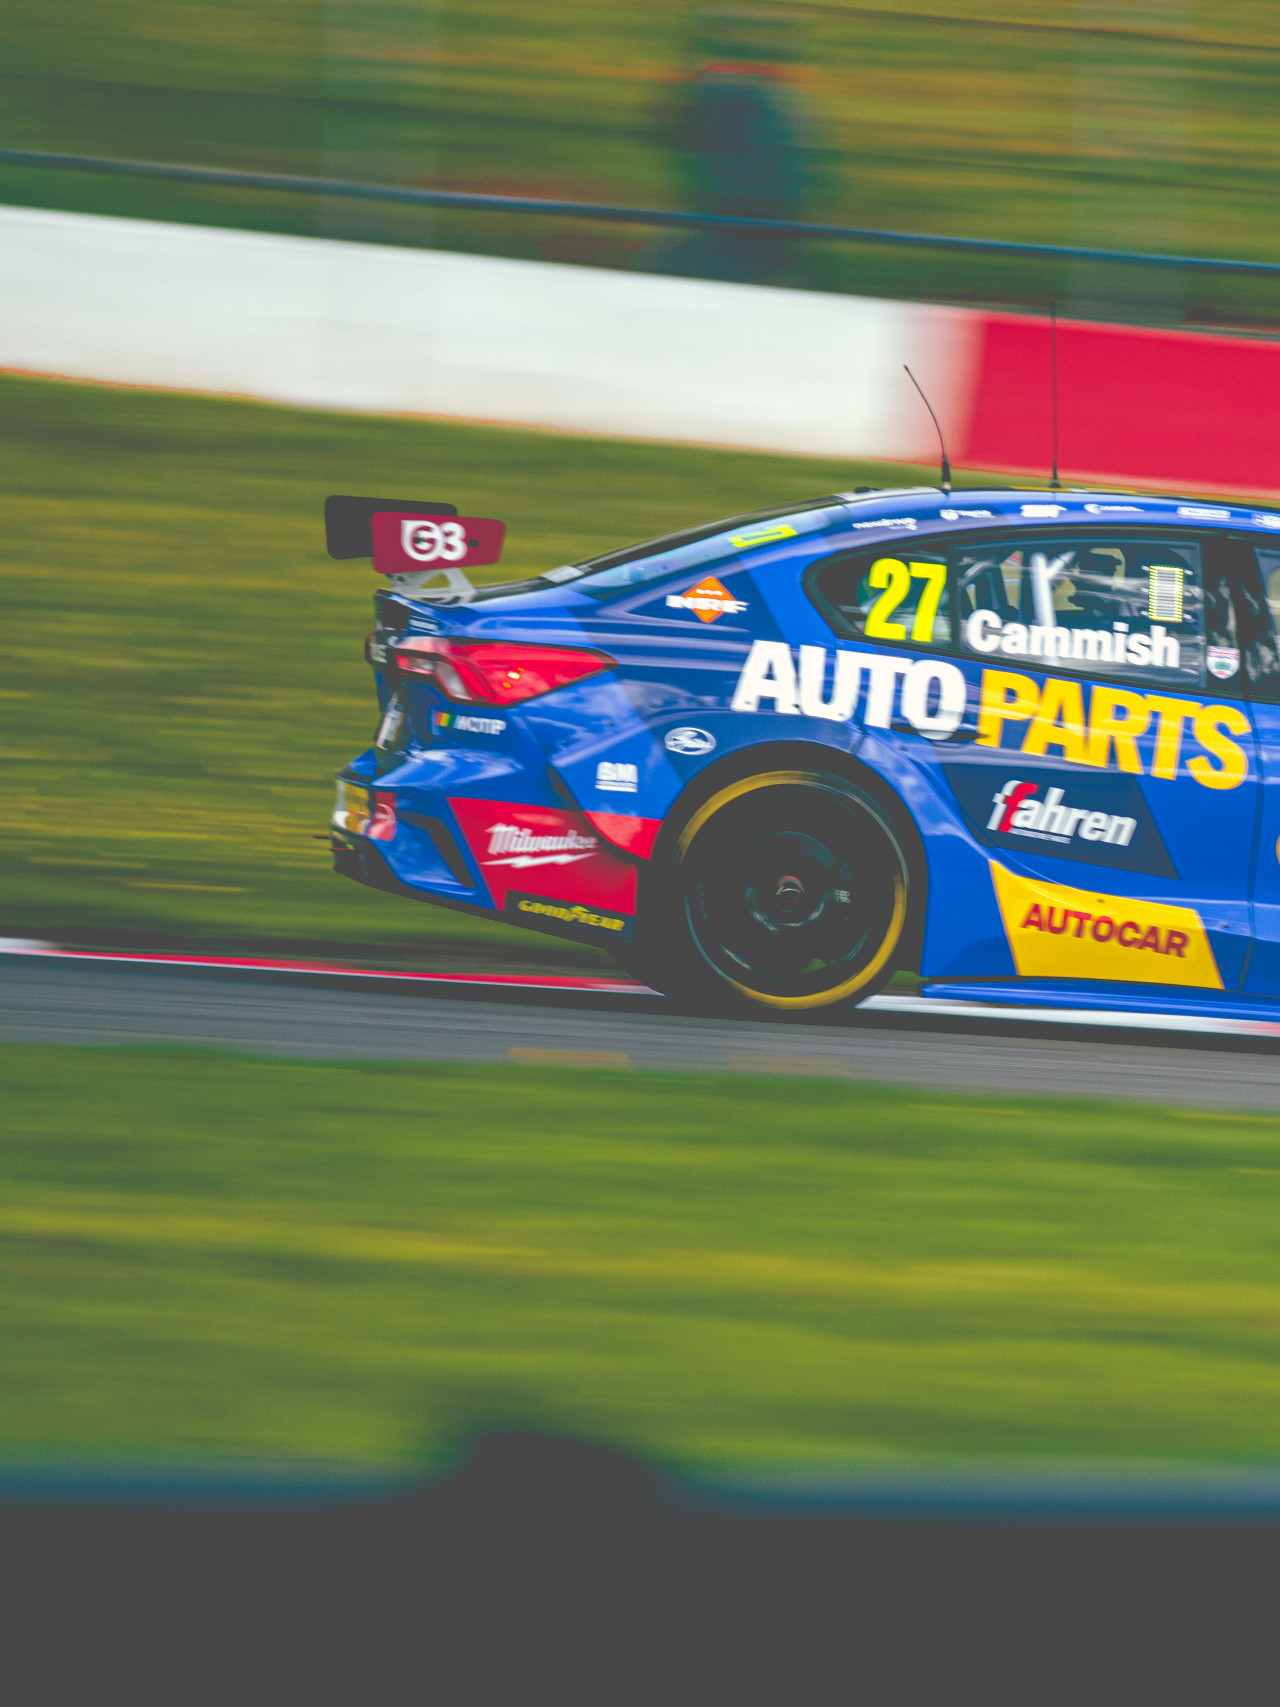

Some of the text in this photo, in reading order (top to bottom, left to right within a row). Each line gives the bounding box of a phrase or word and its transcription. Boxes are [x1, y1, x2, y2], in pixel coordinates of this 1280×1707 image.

[864, 557, 947, 643] 27
[965, 608, 1181, 669] Cammish
[730, 639, 1252, 790] AUTO PARTS
[484, 822, 600, 856] Milwaukee
[986, 779, 1138, 847] fahren
[518, 900, 626, 932] GOODYEAR
[1021, 902, 1190, 959] AUTOCAR
